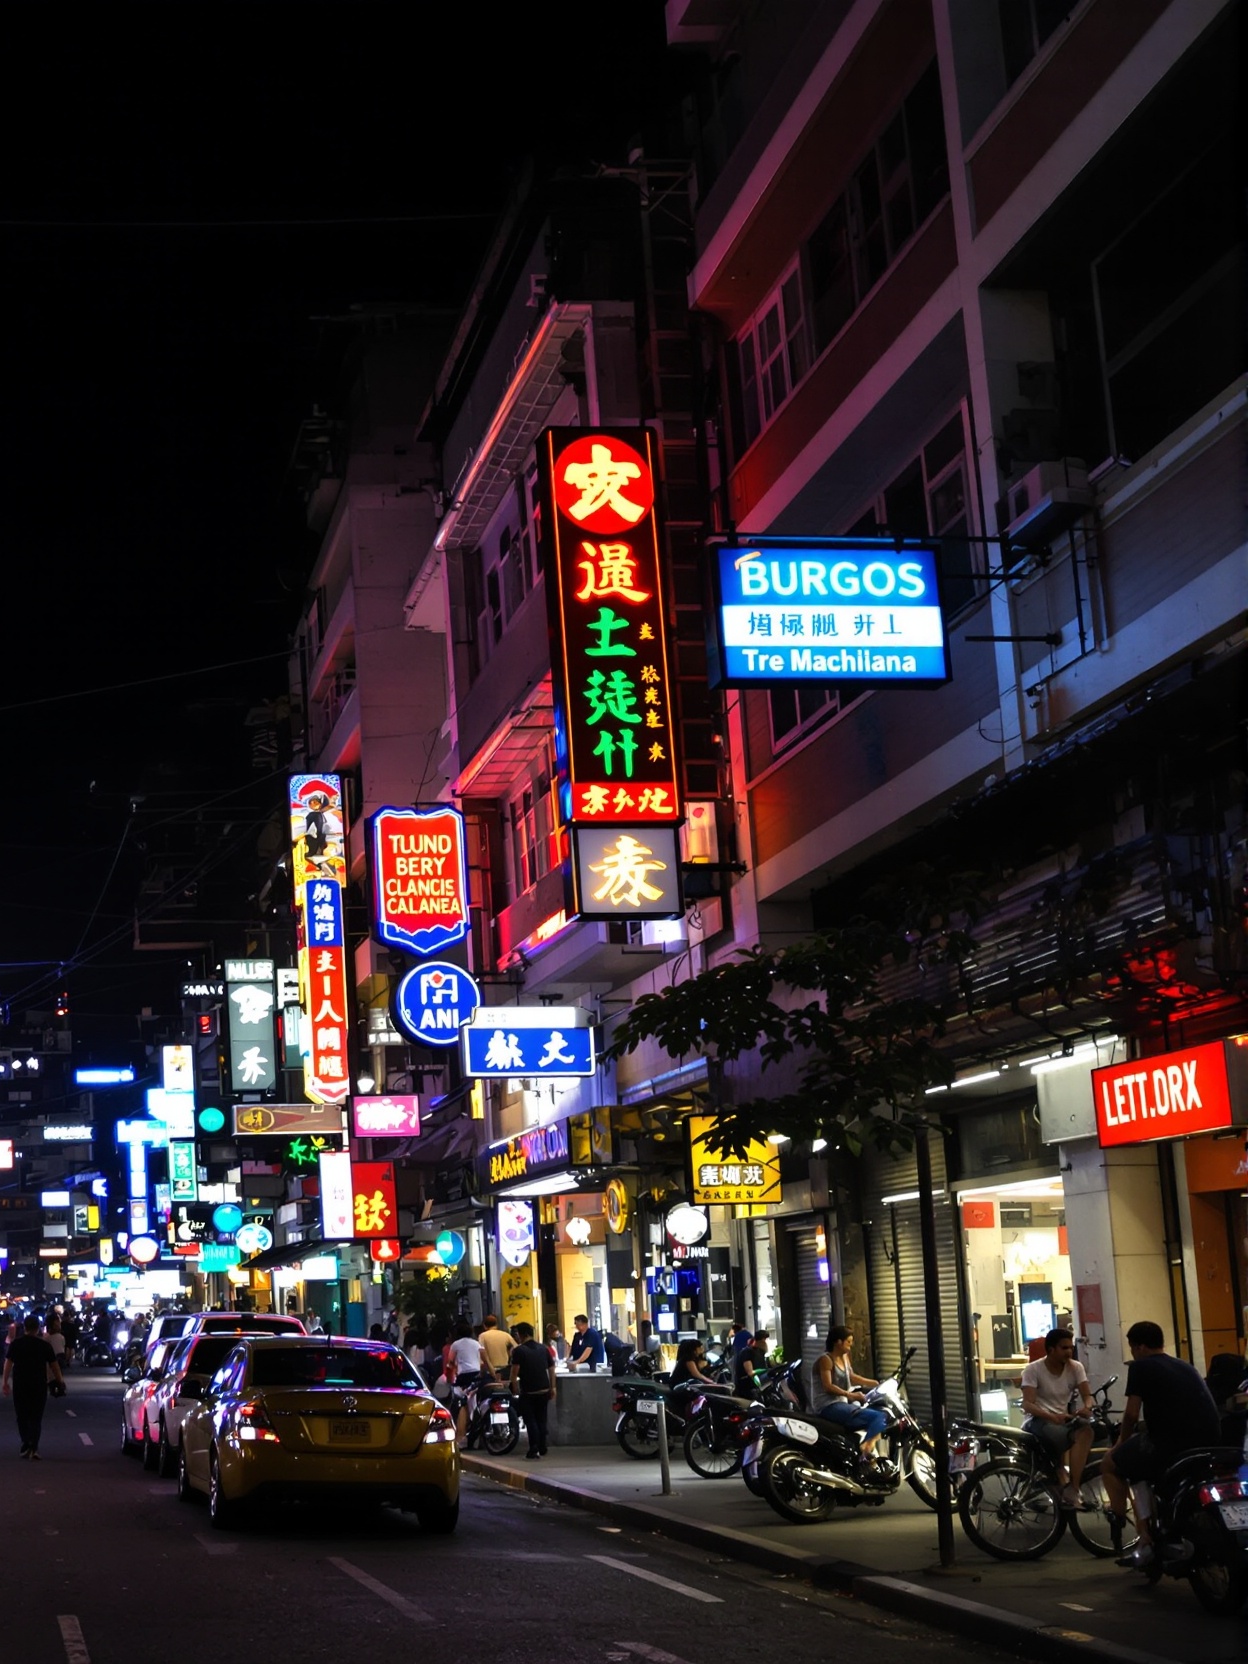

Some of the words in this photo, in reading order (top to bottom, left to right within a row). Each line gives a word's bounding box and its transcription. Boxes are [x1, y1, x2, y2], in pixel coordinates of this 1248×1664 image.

[740, 560, 926, 599] BURGOS
[741, 649, 785, 671] Tre
[395, 857, 446, 876] BERY
[386, 897, 461, 914] CALANEA
